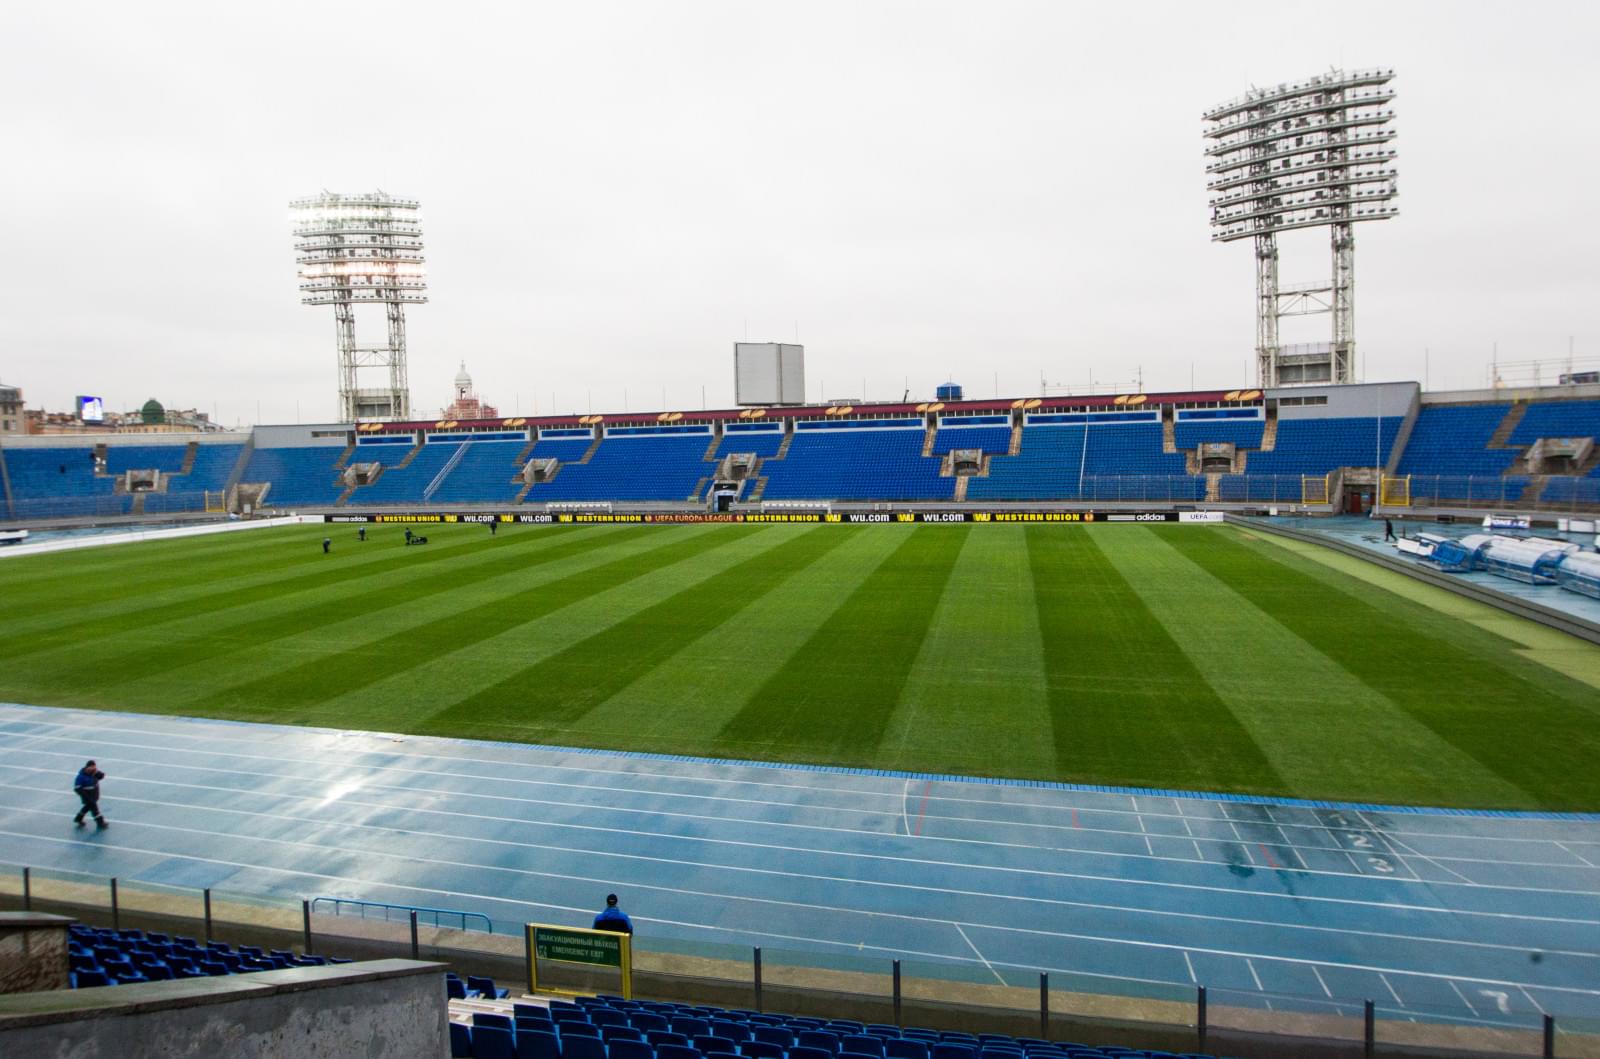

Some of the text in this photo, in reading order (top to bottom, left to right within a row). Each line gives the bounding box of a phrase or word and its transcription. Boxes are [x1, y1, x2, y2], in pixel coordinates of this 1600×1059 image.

[1347, 834, 1374, 848] 2
[1368, 858, 1394, 873] 3
[552, 946, 604, 958] EMERGENCY EXIT
